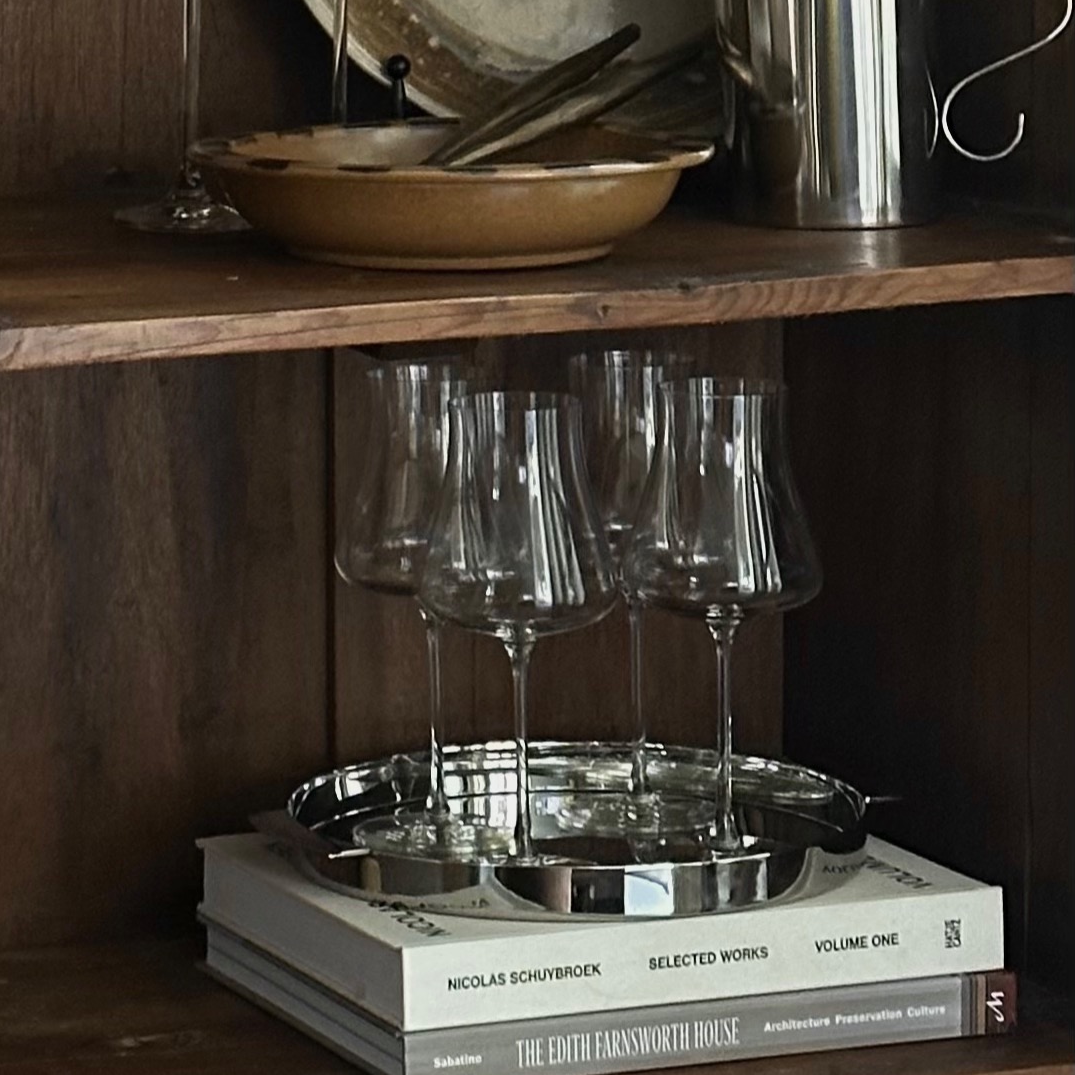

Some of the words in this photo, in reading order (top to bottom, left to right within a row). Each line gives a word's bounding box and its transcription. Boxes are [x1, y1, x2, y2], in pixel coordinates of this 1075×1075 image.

[814, 935, 869, 954] VOLUME
[871, 932, 900, 947] ONE
[648, 950, 717, 971] SELECTED
[720, 945, 769, 964] WORKS
[447, 972, 506, 991] NICOLAS
[510, 963, 602, 985] SCHUYBROEK
[763, 1016, 830, 1033] Architecture
[835, 1008, 903, 1026] Preservation
[907, 1004, 945, 1019] Culture
[515, 1037, 545, 1069] THE
[548, 1031, 592, 1066] EDITH
[595, 1021, 691, 1061] FARNSWORTH
[693, 1016, 740, 1052] HOUSE
[433, 1052, 482, 1069] Sabatino
